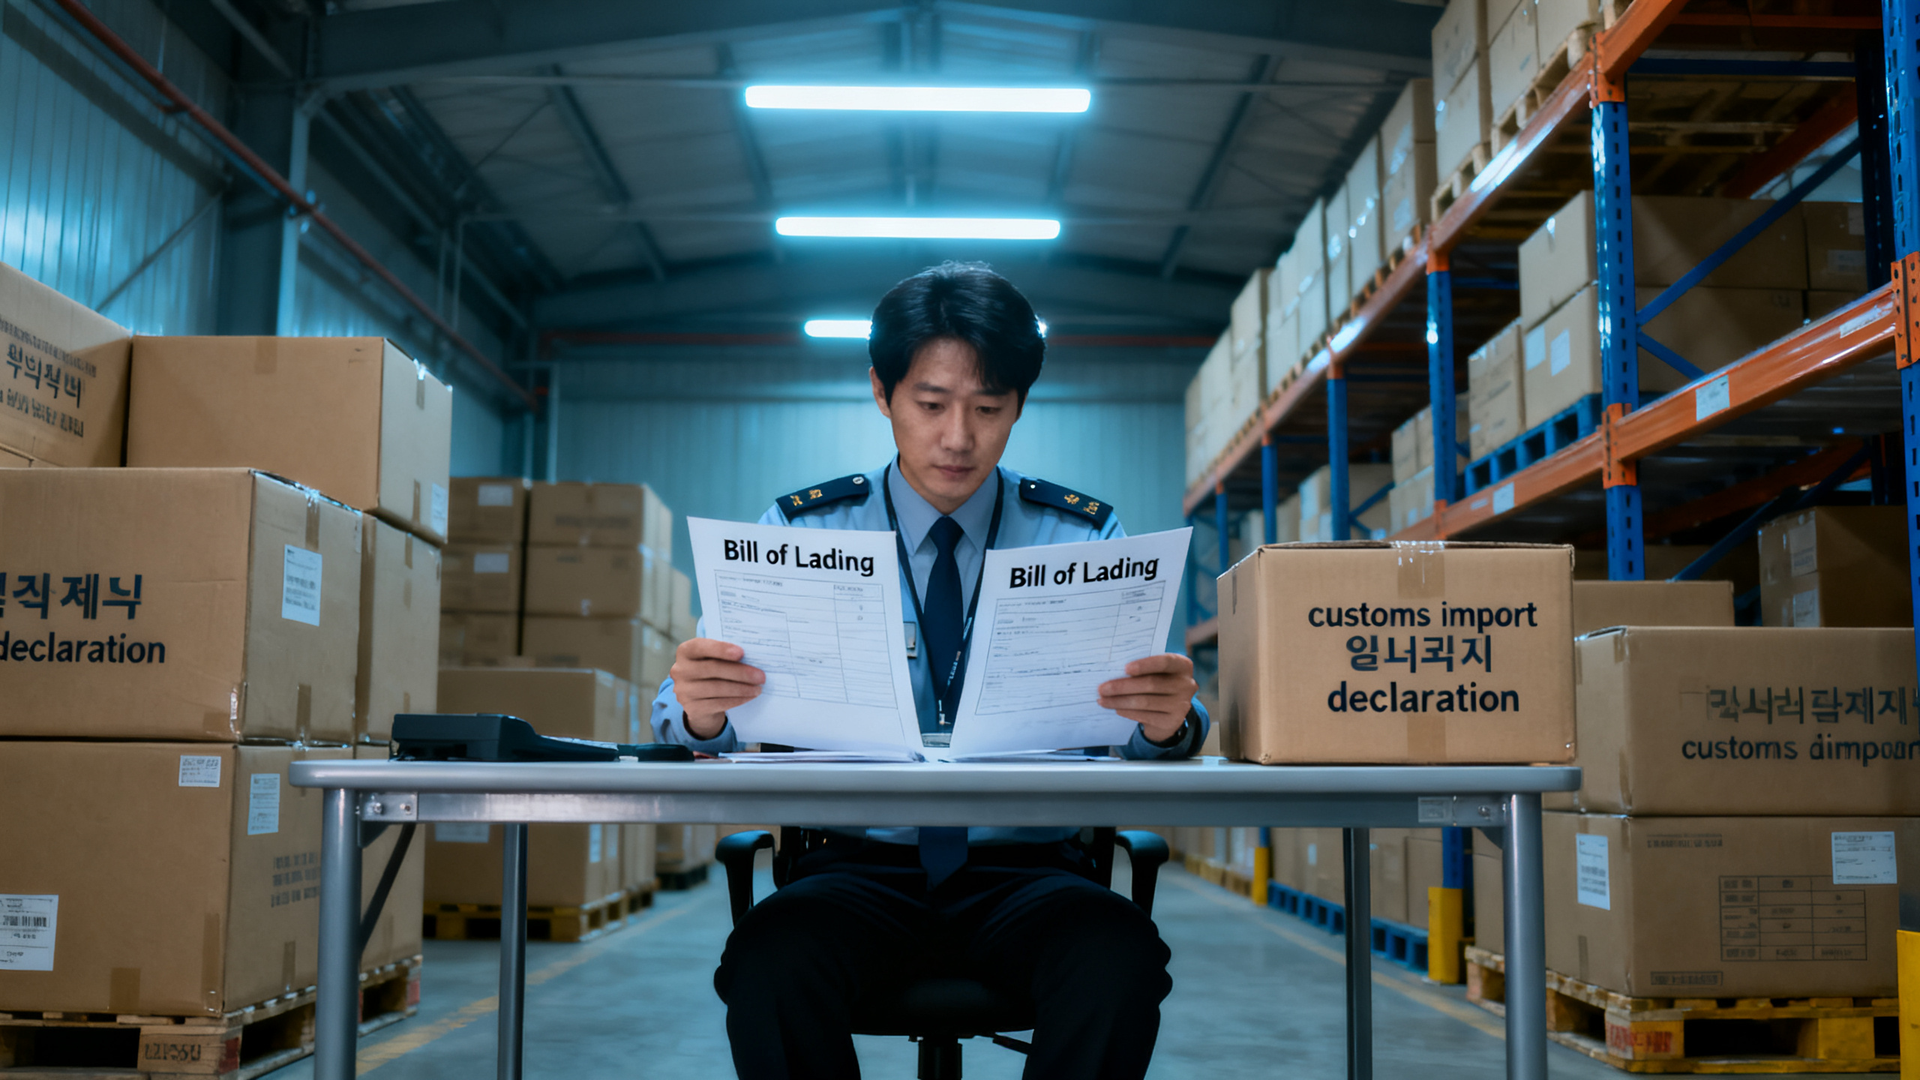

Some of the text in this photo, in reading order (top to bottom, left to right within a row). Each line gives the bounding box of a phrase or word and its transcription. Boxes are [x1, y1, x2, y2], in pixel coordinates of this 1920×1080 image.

[724, 539, 874, 577] Bill of Lading
[1009, 557, 1160, 589] Bill of Lading
[1308, 601, 1538, 634] customs import
[1327, 680, 1519, 713] declaration
[1682, 736, 1799, 761] customs
